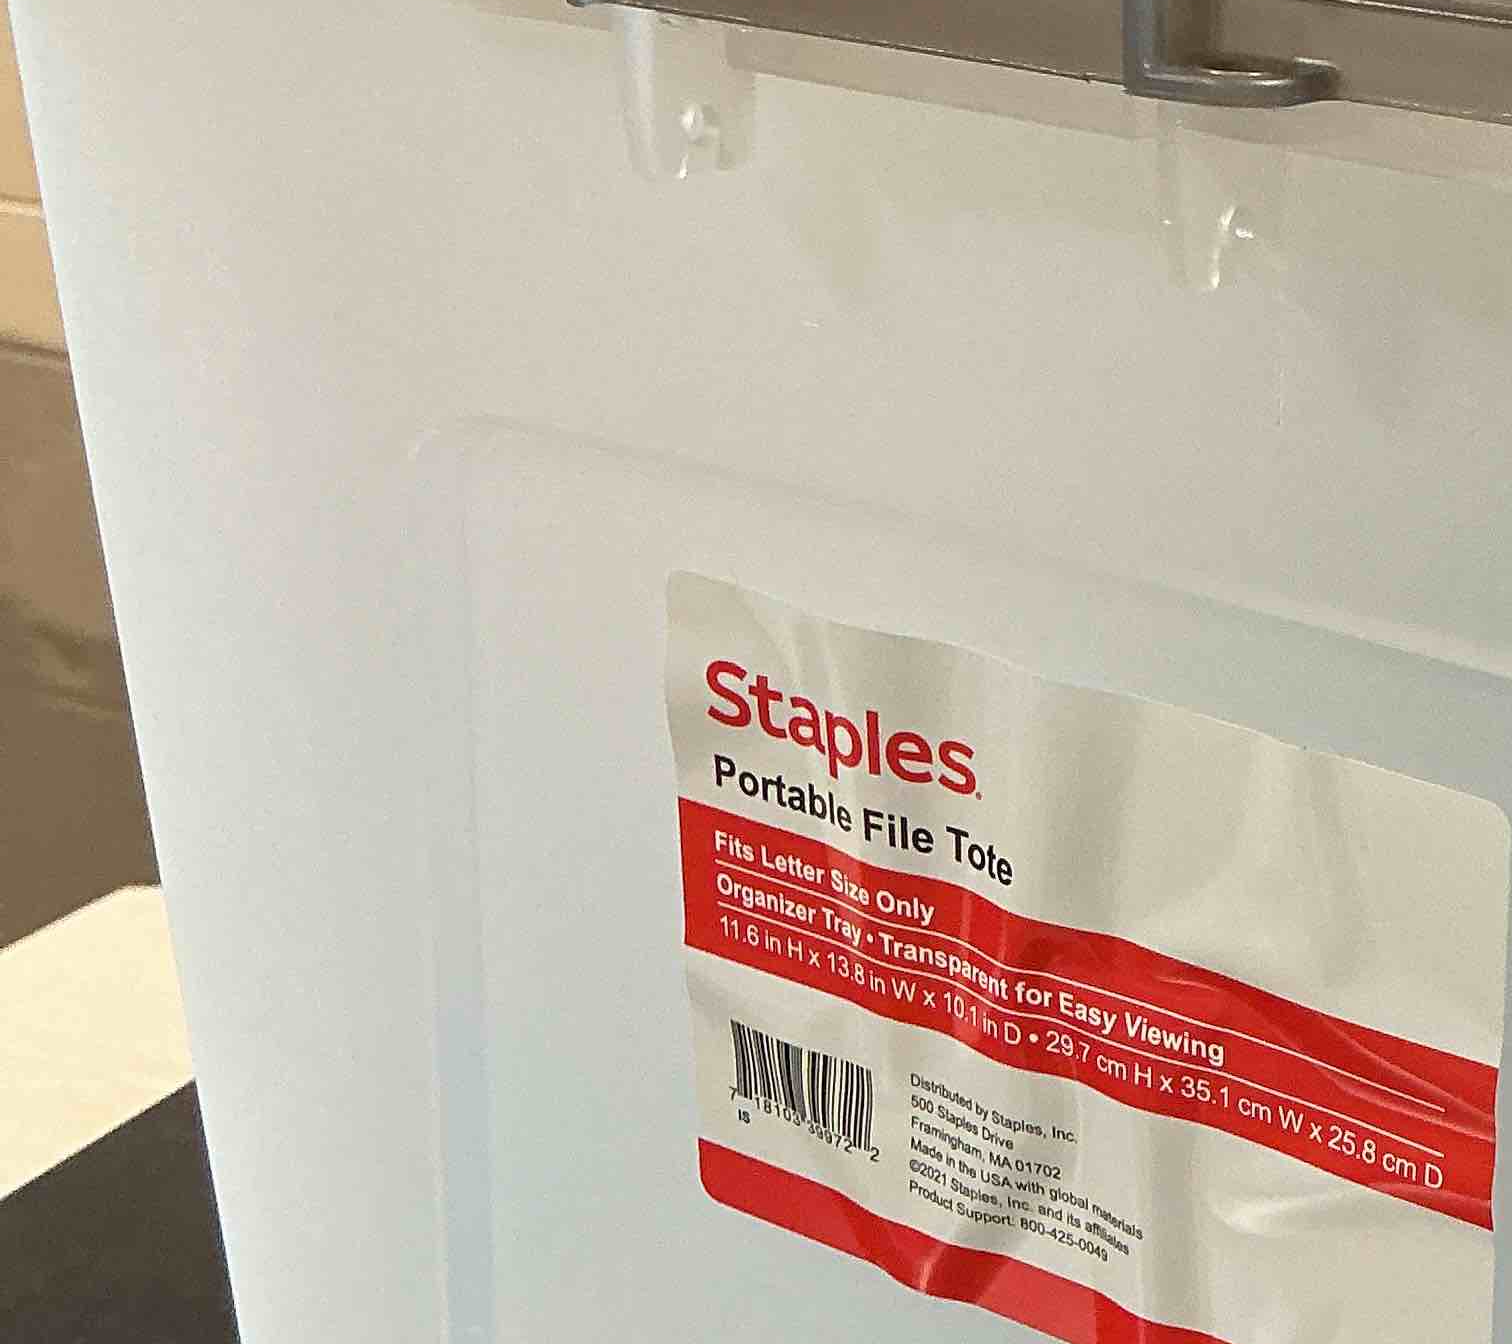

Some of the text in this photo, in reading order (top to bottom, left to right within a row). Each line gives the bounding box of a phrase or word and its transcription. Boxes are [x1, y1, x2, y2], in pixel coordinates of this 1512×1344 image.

[714, 754, 1013, 886] Portable File Tote
[714, 830, 935, 926] Fits Letter Size Only
[716, 873, 1224, 1066] Organizer Tray Transparent for Easy Viewing
[719, 915, 1444, 1189] 11.6 in H x 13.8 in W x 10.1 in D 29.7 cm H x 35.1 cm W x 25.8 cm D
[729, 1086, 738, 1101] 7
[755, 1097, 801, 1126] 18103
[870, 1147, 880, 1162] 2
[910, 1073, 1078, 1144] Distributed by Staples, Inc.
[911, 1095, 1014, 1150] 500 Staples Drive
[911, 1116, 1062, 1180] Framingham, MA 01702
[909, 1180, 953, 1211] Product
[1020, 1216, 1109, 1262] 800-425-0049
[910, 1136, 1144, 1241] Made in the USA with global materials
[1038, 1203, 1063, 1222] and
[1066, 1213, 1081, 1229] its
[1084, 1220, 1130, 1256] affiliates
